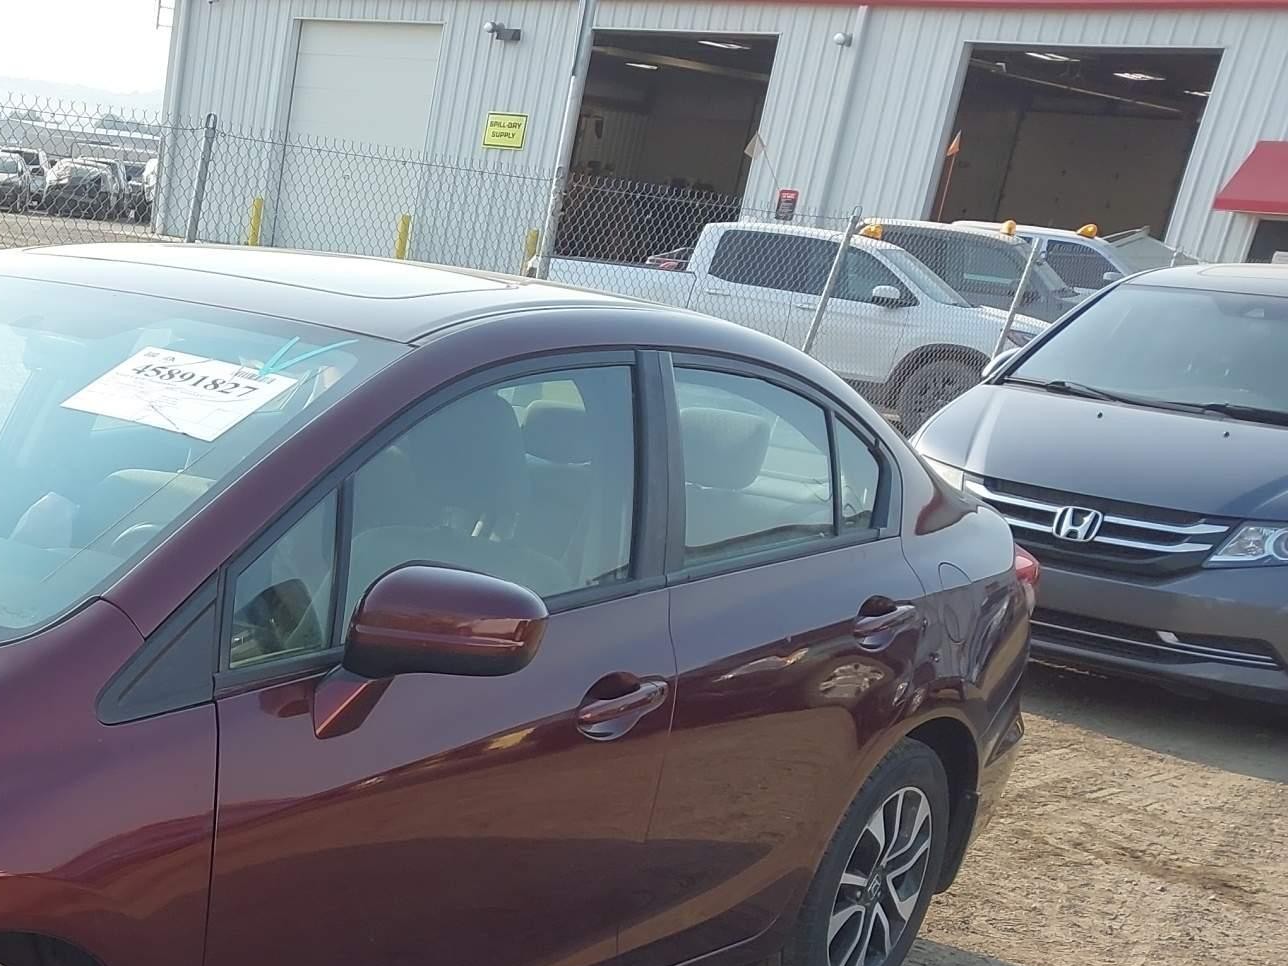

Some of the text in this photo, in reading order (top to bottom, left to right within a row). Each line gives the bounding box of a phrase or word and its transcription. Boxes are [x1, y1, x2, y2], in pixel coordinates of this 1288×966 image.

[490, 121, 522, 129] SPILL-DRY
[491, 131, 516, 139] SUPPLY
[132, 363, 259, 398] 45891827
